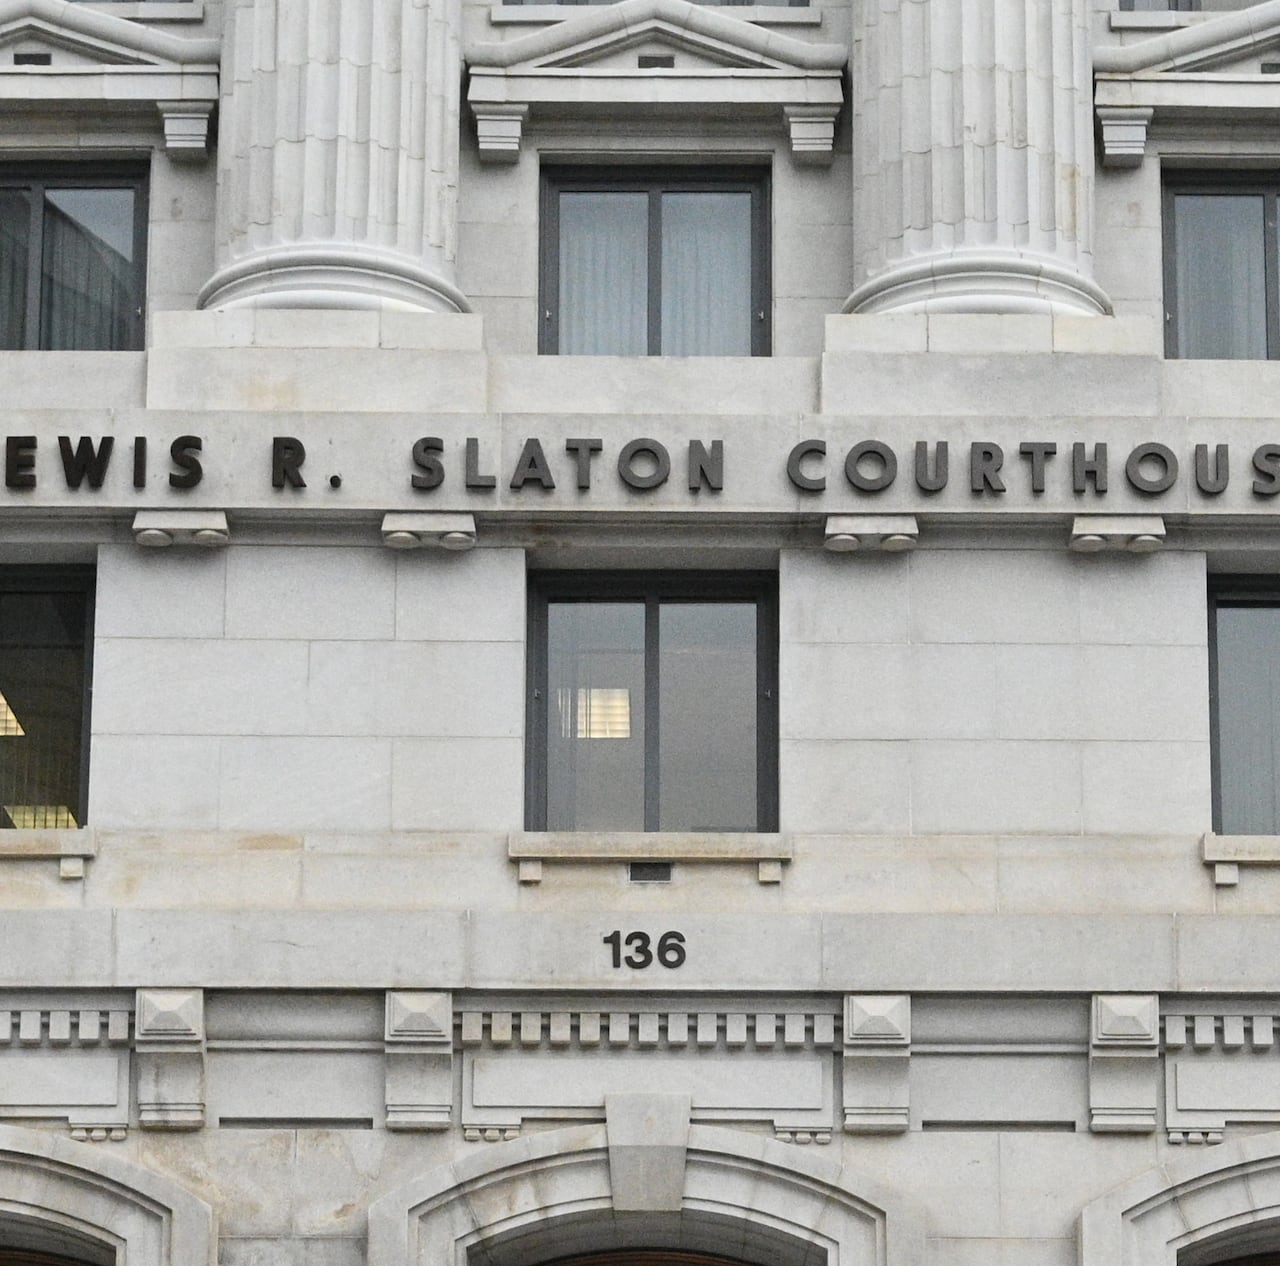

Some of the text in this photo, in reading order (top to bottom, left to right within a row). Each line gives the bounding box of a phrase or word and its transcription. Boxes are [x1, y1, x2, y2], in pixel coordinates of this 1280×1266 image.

[271, 436, 343, 489] R.
[410, 437, 724, 491] SLATON
[603, 930, 686, 969] 136
